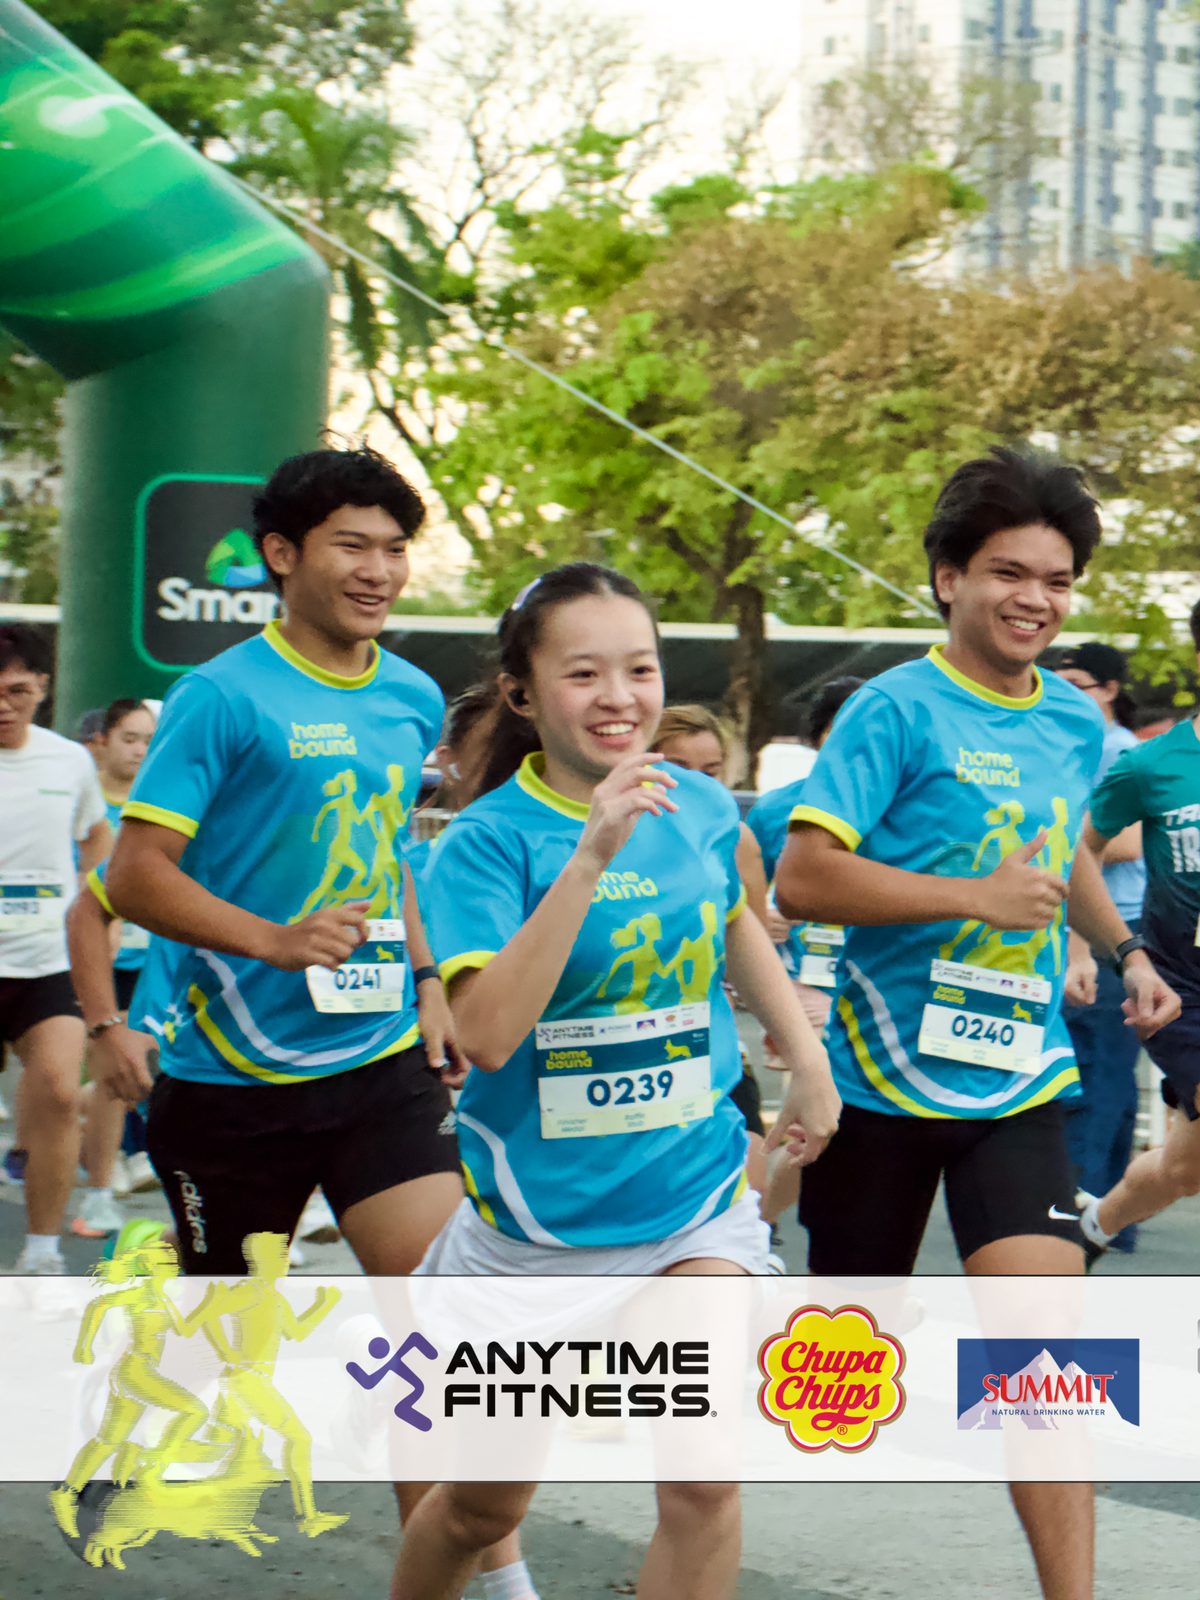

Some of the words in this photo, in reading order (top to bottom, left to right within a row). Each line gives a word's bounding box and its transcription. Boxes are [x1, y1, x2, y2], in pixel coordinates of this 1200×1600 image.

[157, 577, 286, 624] Smar
[291, 722, 348, 738] home
[288, 736, 357, 759] bound
[959, 747, 1014, 768] home
[956, 764, 1020, 787] bound
[592, 878, 658, 902] ound
[334, 967, 382, 990] 0241
[552, 1025, 594, 1034] ANYTIME
[552, 1031, 595, 1040] FITNESS
[952, 1015, 1014, 1046] 0240
[546, 1057, 592, 1070] bound
[549, 1050, 588, 1059] home
[587, 1070, 673, 1107] 0239
